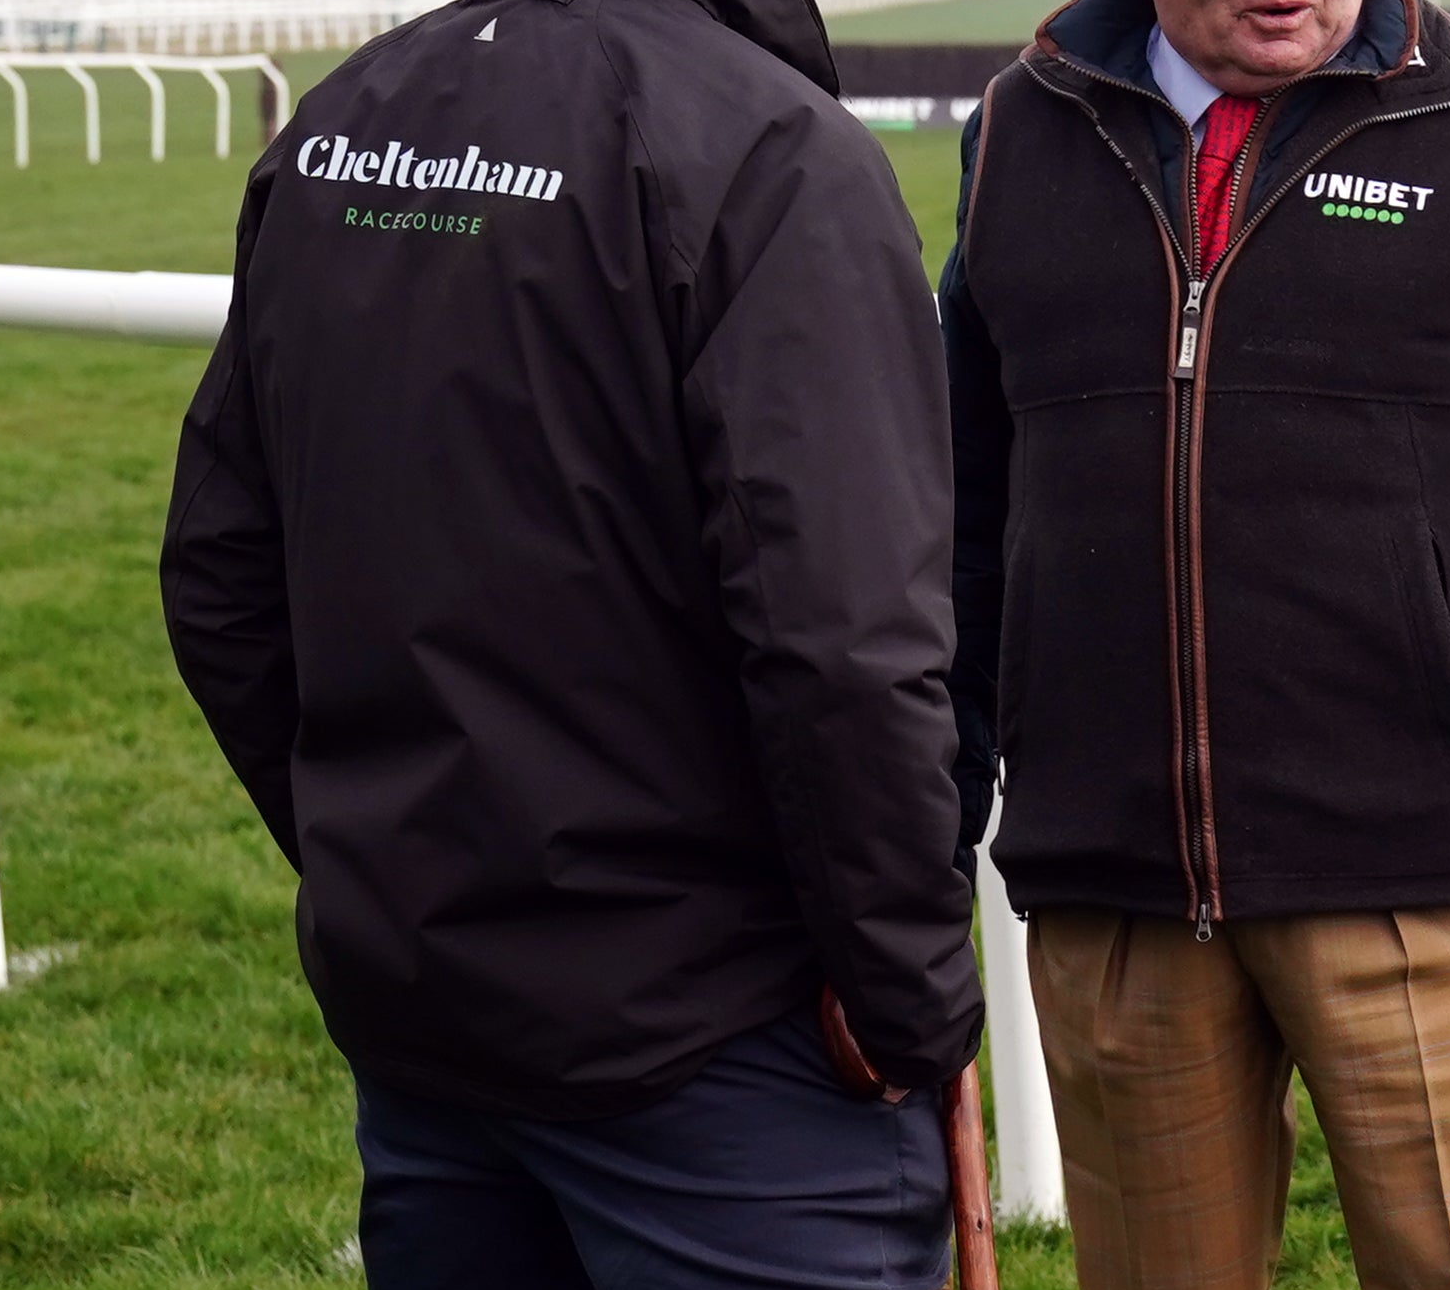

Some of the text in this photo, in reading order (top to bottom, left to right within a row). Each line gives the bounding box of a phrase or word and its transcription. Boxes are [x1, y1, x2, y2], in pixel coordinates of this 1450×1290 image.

[297, 135, 564, 201] Cheltenham
[1304, 173, 1435, 211] UNIBET
[345, 207, 483, 236] RACECOURSE
